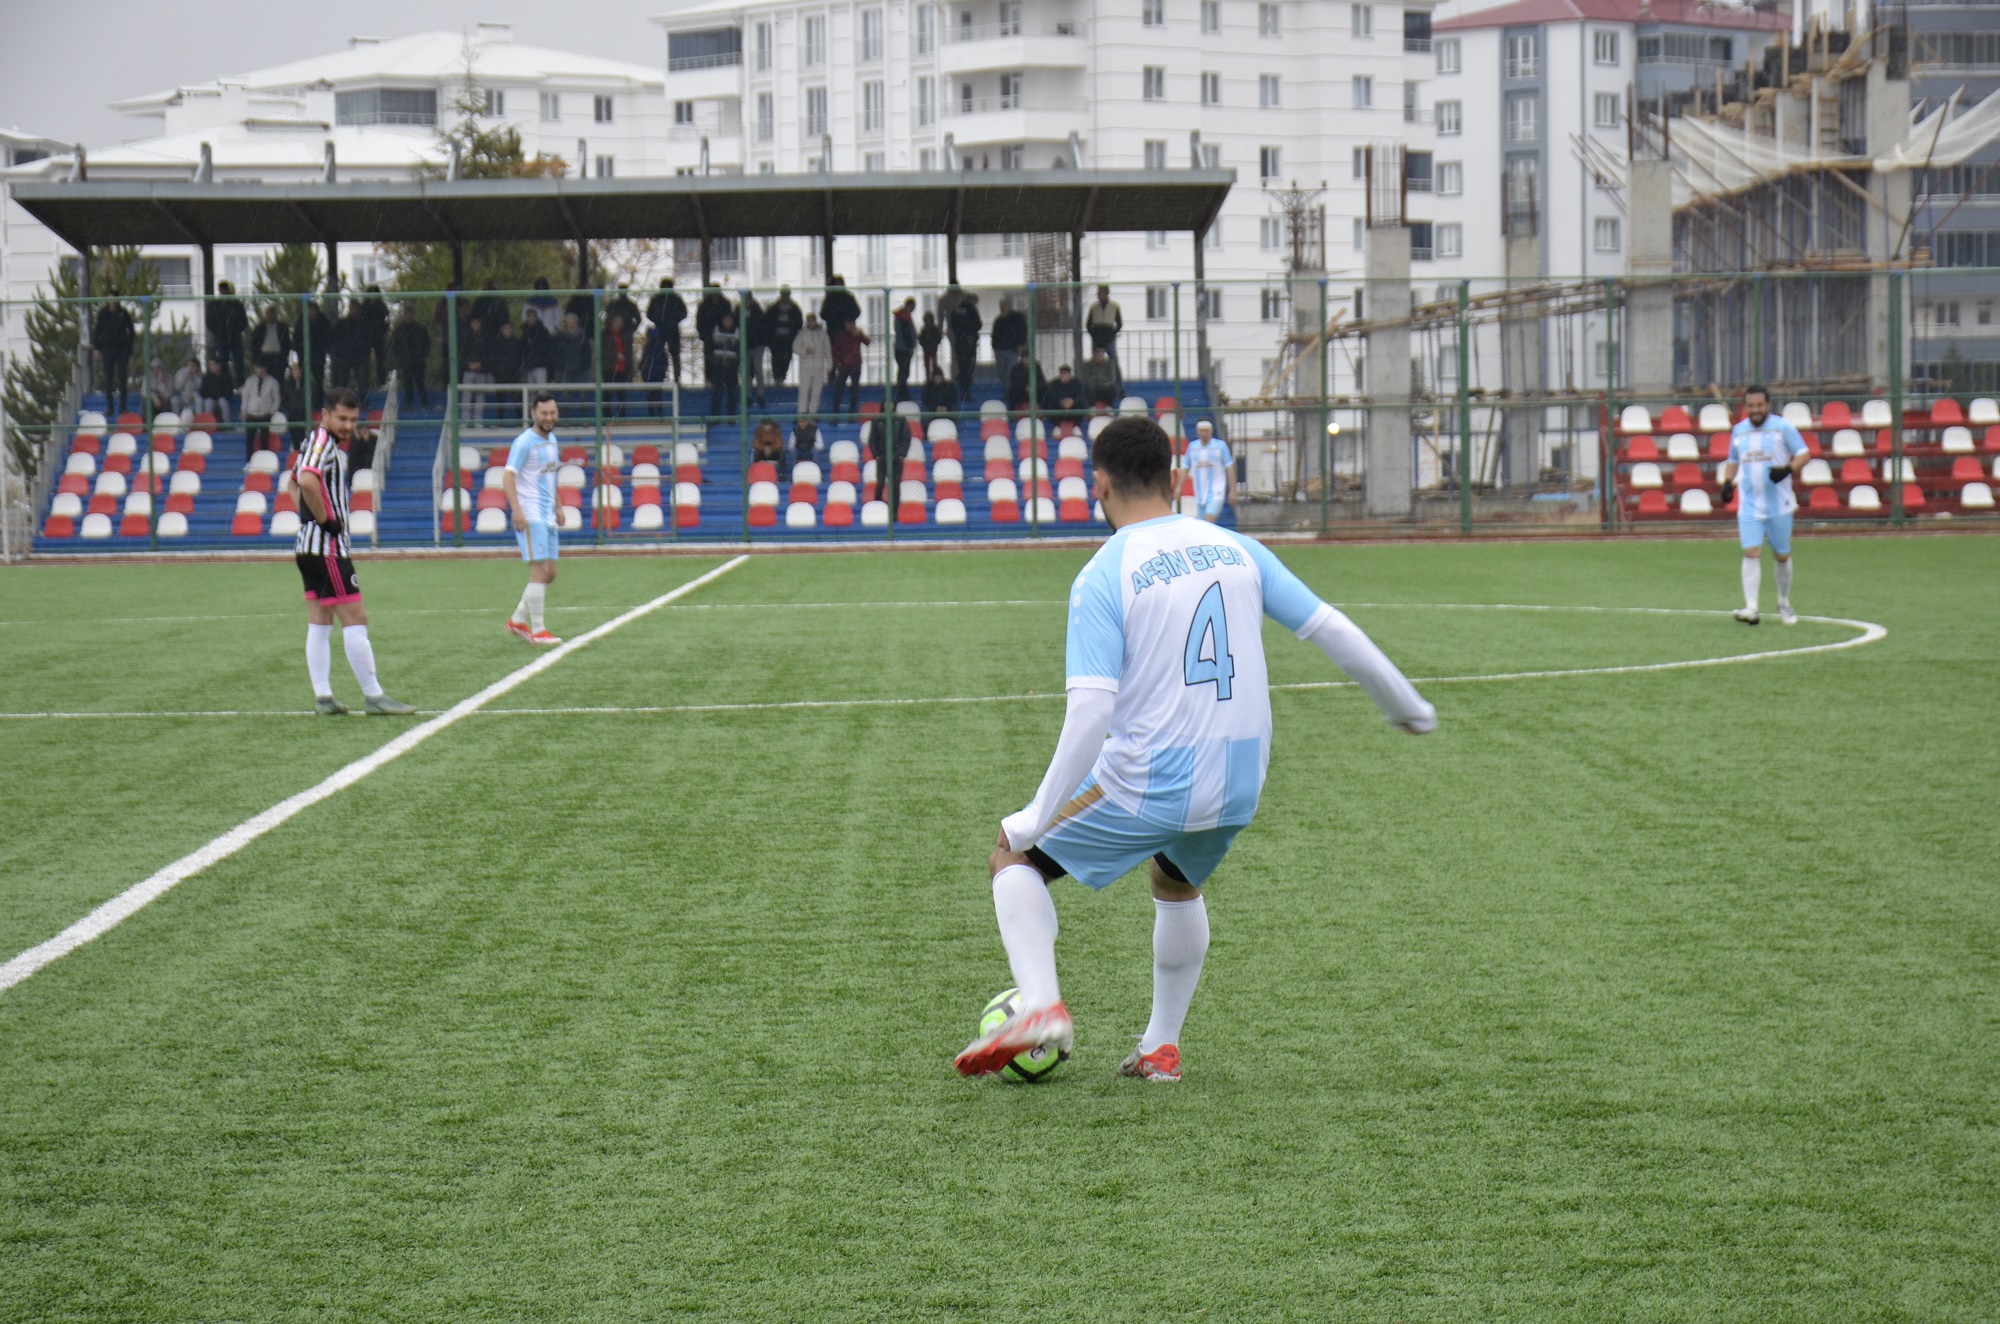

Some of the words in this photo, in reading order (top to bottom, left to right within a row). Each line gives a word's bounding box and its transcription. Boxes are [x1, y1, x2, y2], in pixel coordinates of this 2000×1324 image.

[1131, 549, 1190, 595] AFŞİN
[1186, 545, 1246, 571] SPOR
[1184, 580, 1235, 701] 4
